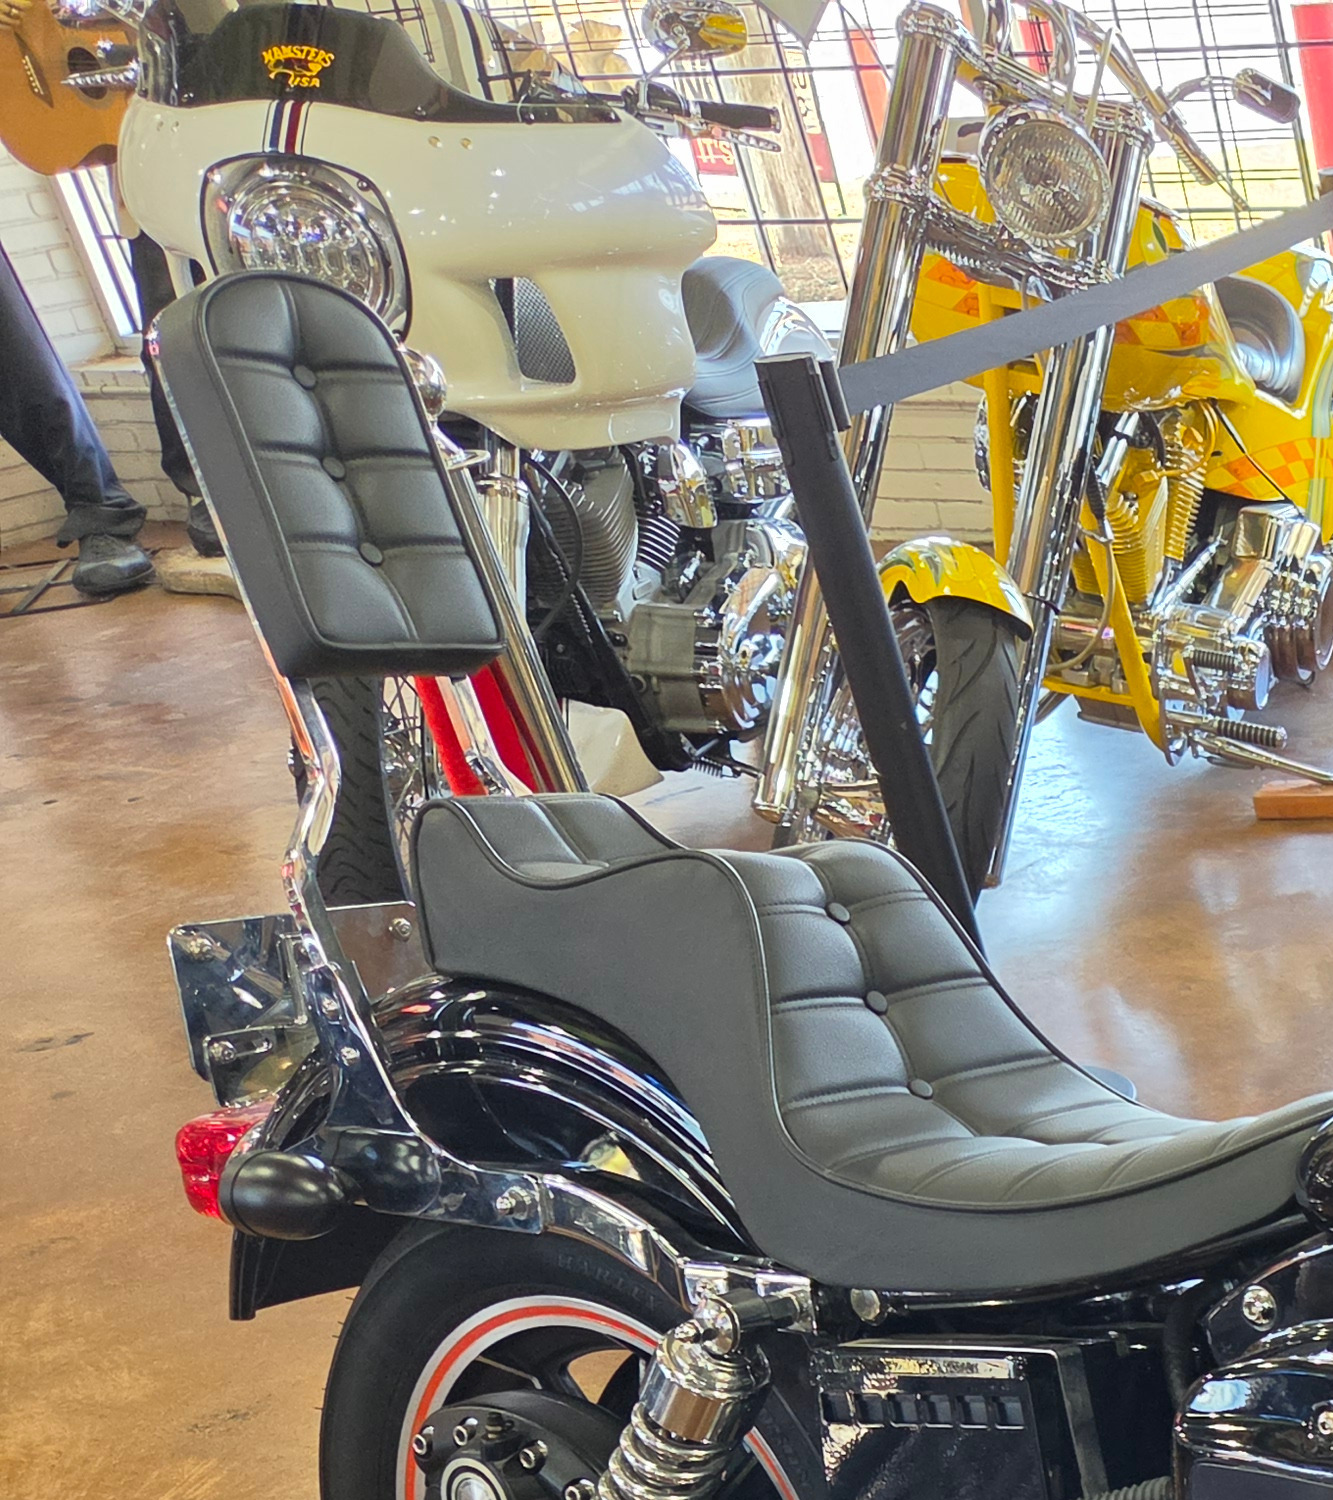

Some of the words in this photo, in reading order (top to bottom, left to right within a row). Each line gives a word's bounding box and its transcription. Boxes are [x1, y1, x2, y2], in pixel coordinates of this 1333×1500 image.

[262, 45, 335, 67] HAMSTERS
[288, 76, 321, 88] USA
[697, 139, 734, 165] IT'S
